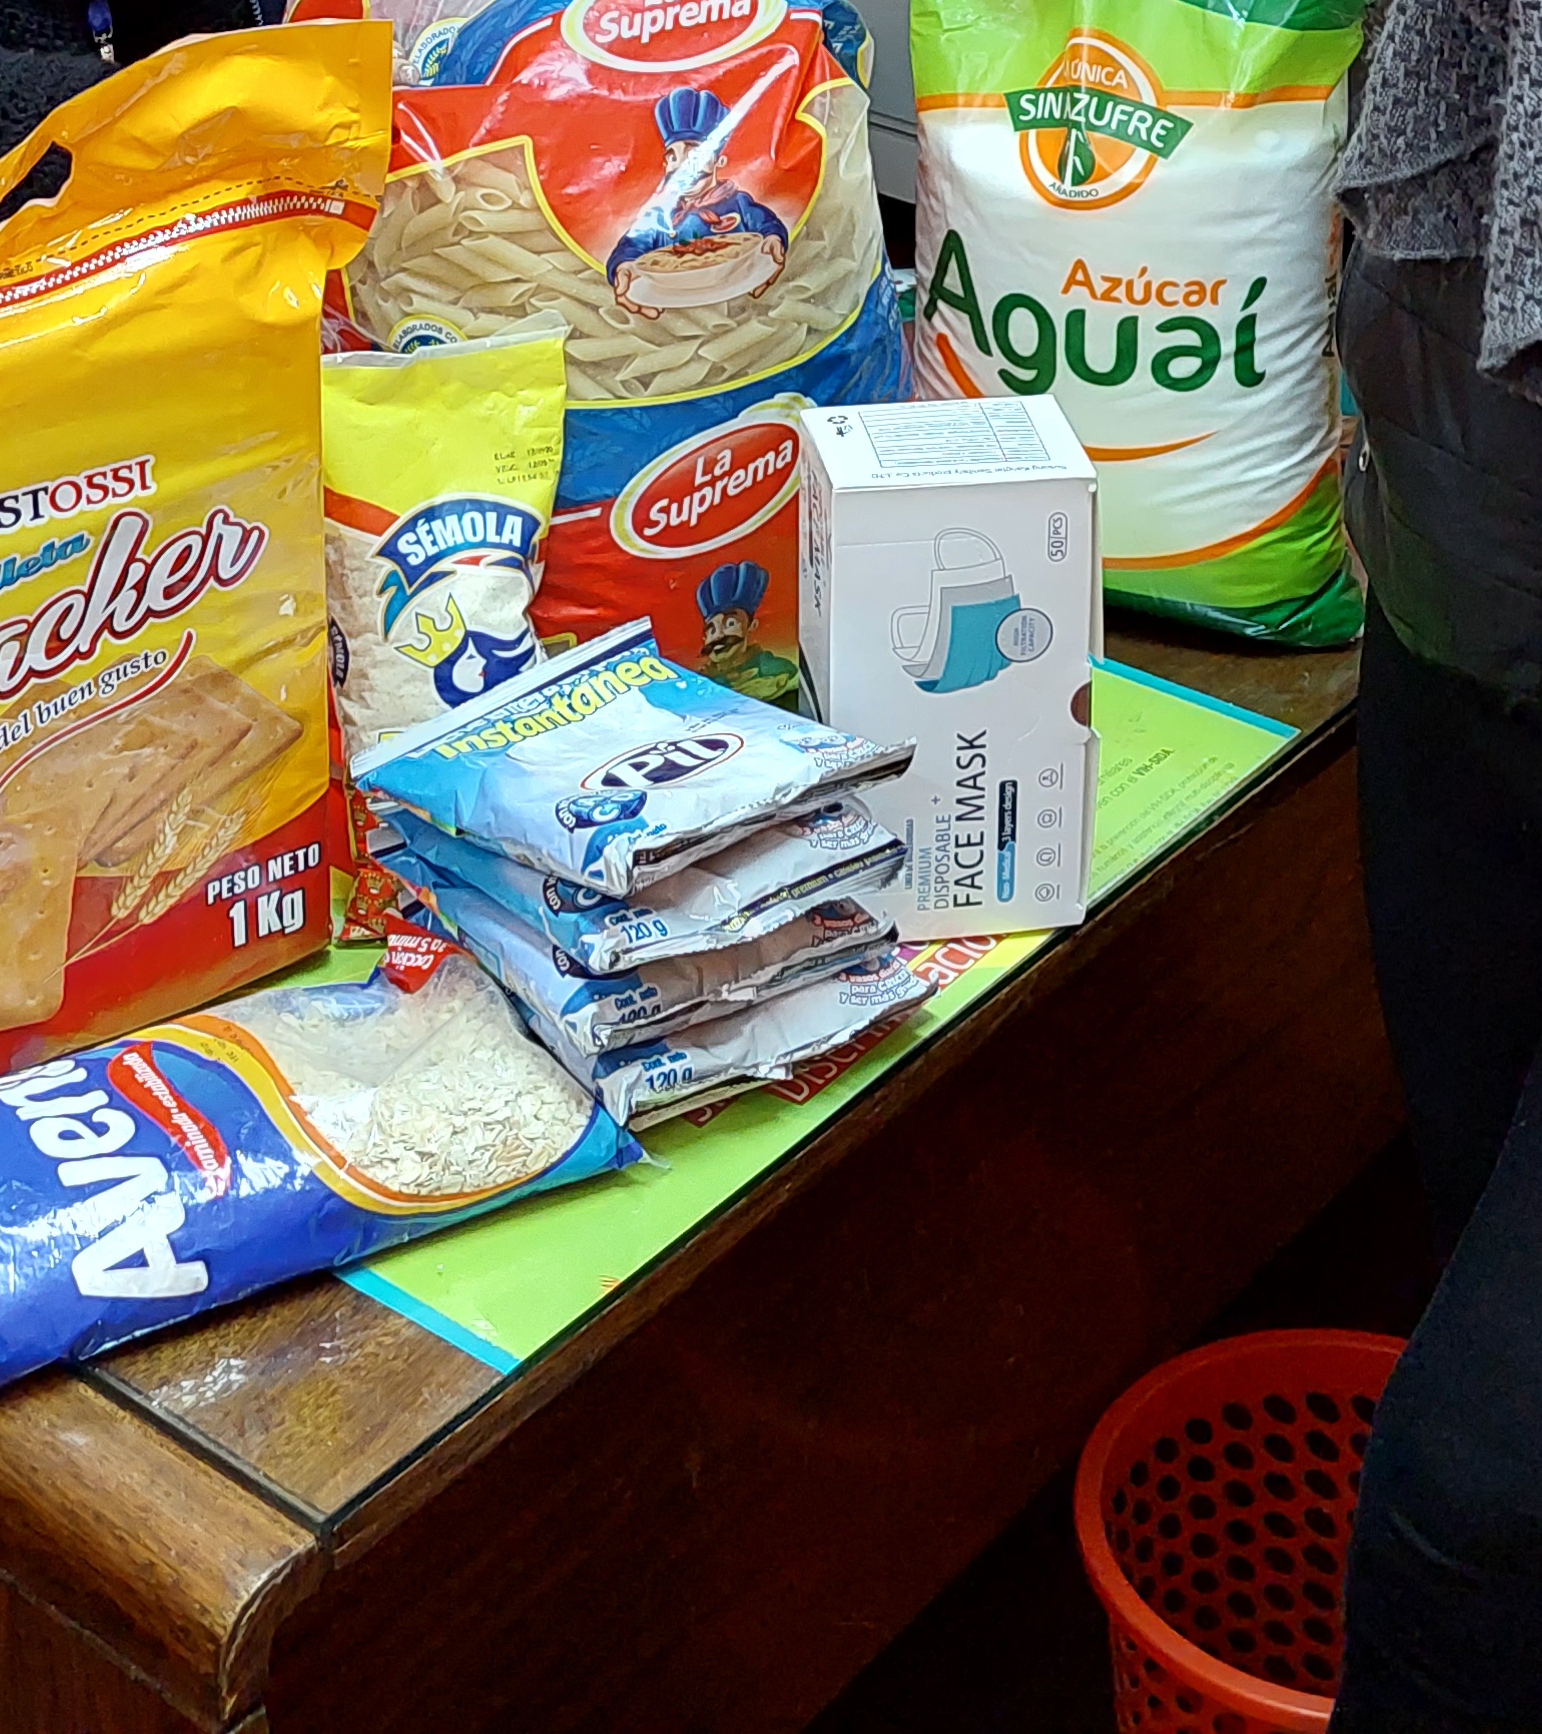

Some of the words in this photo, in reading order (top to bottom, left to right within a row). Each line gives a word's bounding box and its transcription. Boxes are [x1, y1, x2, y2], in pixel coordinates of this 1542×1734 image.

[1070, 57, 1129, 91] ÚNICA
[1018, 92, 1062, 123] SIN
[1060, 258, 1228, 308] Azúcar
[923, 228, 1269, 396] Aguaí
[643, 437, 793, 537] Suprema
[693, 446, 732, 484] La
[396, 512, 524, 567] SÉMOLA
[1050, 539, 1065, 559] 50
[1051, 516, 1064, 536] PCS
[37, 682, 95, 726] buen
[97, 649, 167, 699] gusto
[616, 737, 723, 788] Pil
[954, 729, 988, 822] MASK
[206, 866, 260, 906] PESO
[267, 845, 323, 883] NETO
[916, 846, 933, 912] PREMIUM
[933, 813, 952, 910] DISPOSABLE
[952, 830, 984, 908] FACE
[228, 904, 248, 948] 1
[257, 889, 305, 936] Kg
[417, 937, 433, 953] 5
[621, 921, 653, 945] 120
[653, 918, 669, 939] g
